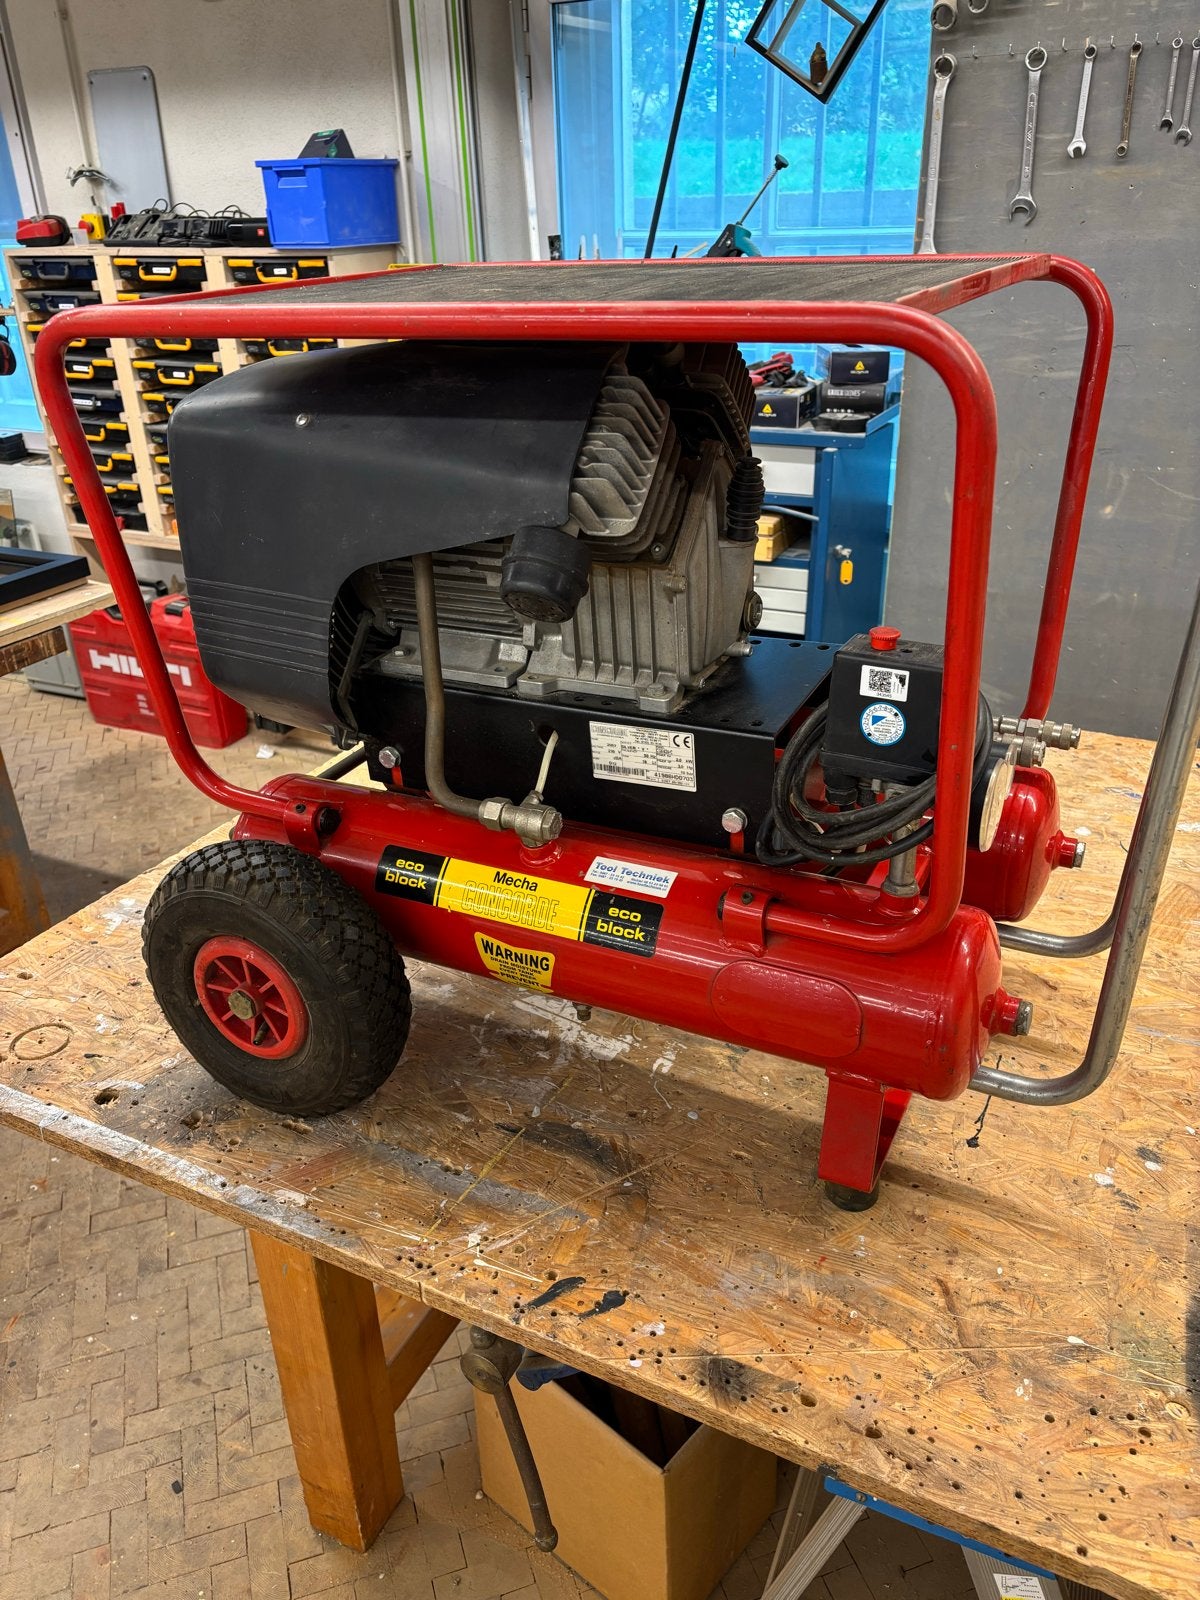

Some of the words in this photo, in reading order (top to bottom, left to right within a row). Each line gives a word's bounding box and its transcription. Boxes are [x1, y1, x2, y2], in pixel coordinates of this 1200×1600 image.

[395, 858, 425, 873] eco
[595, 861, 618, 873] Tool
[620, 866, 671, 885] Techniek
[384, 870, 427, 890] block
[493, 871, 539, 892] Mecha
[461, 880, 560, 932] CONCORDE
[608, 906, 642, 922] eco
[596, 918, 645, 942] block
[480, 937, 550, 972] WARNING
[490, 956, 509, 966] DRAIN
[510, 962, 541, 975] MOISTURE
[499, 963, 517, 972] FROM
[518, 968, 535, 977] TANK
[500, 972, 540, 988] PREVENT
